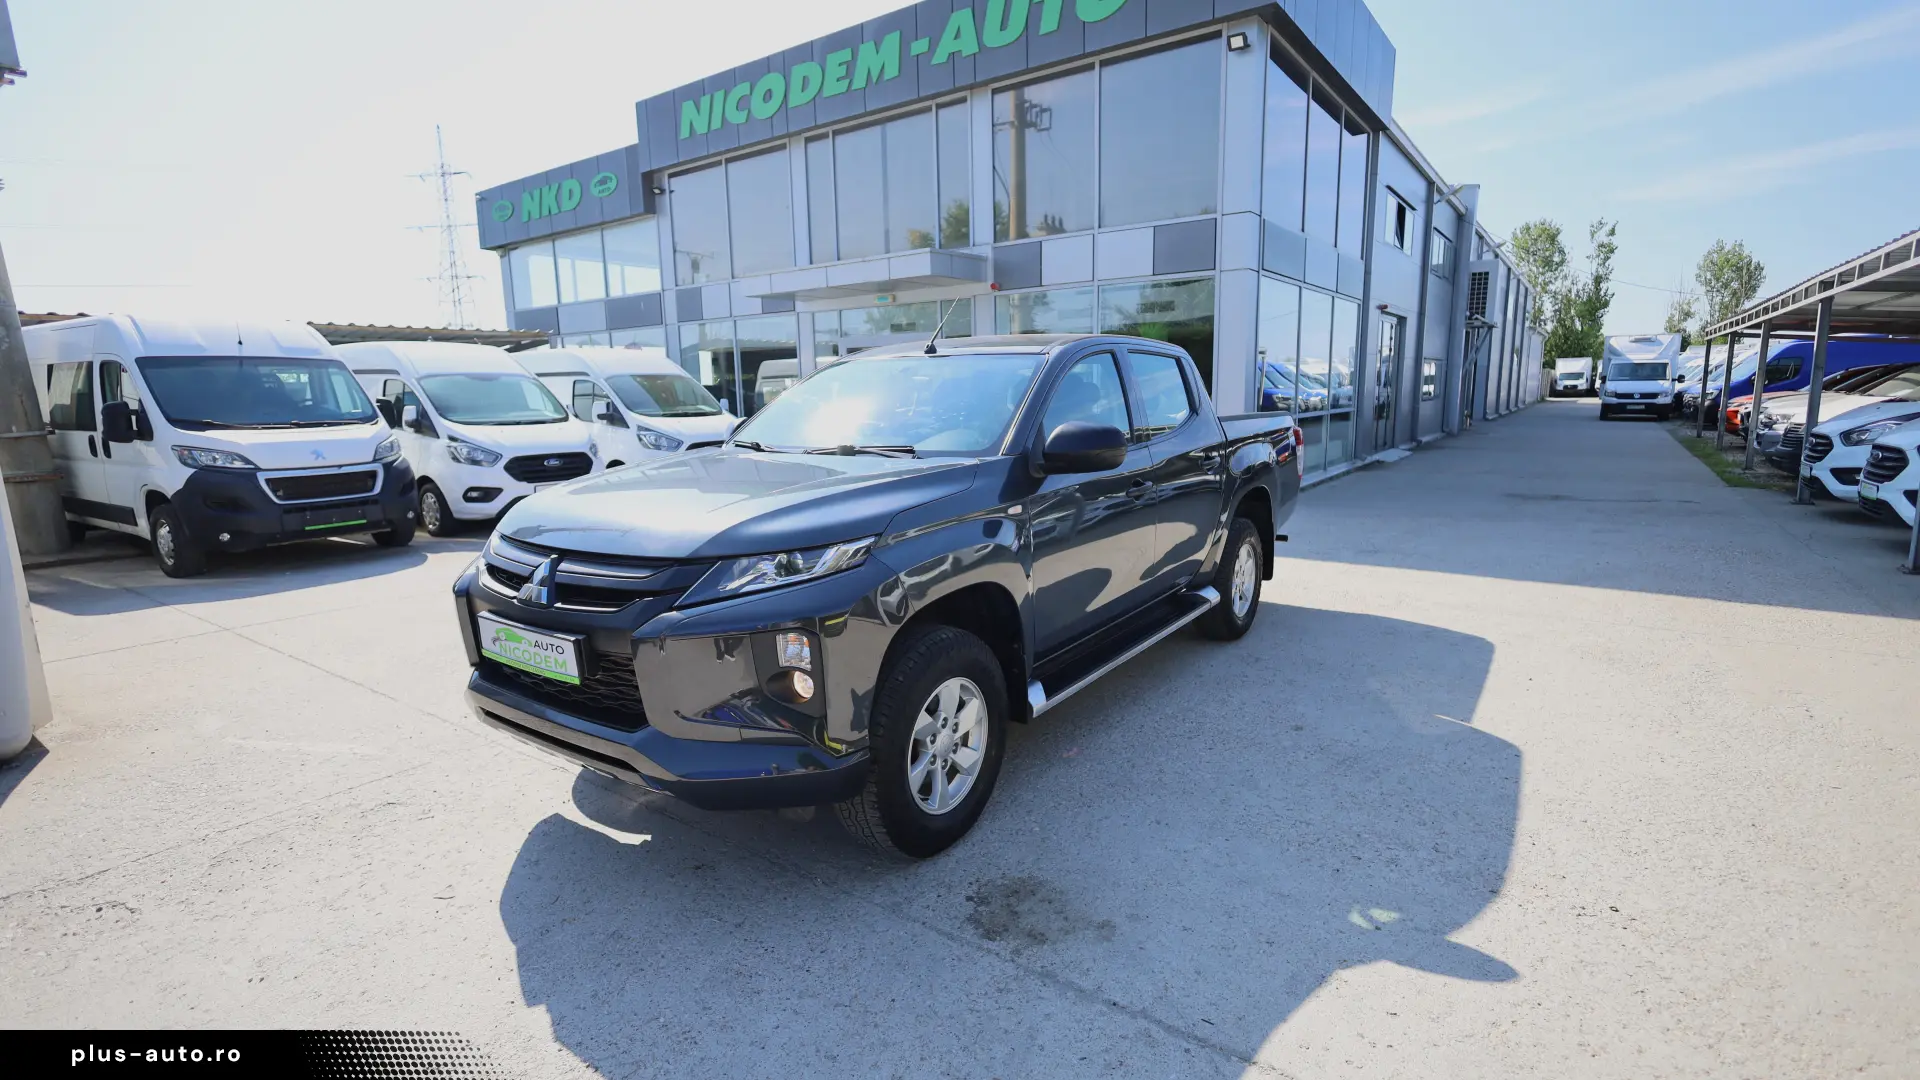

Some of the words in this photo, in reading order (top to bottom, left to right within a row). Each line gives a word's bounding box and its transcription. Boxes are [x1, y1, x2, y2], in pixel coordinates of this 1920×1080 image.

[521, 178, 582, 223] NKD
[499, 642, 568, 672] NICODEM
[534, 640, 565, 655] AUTO
